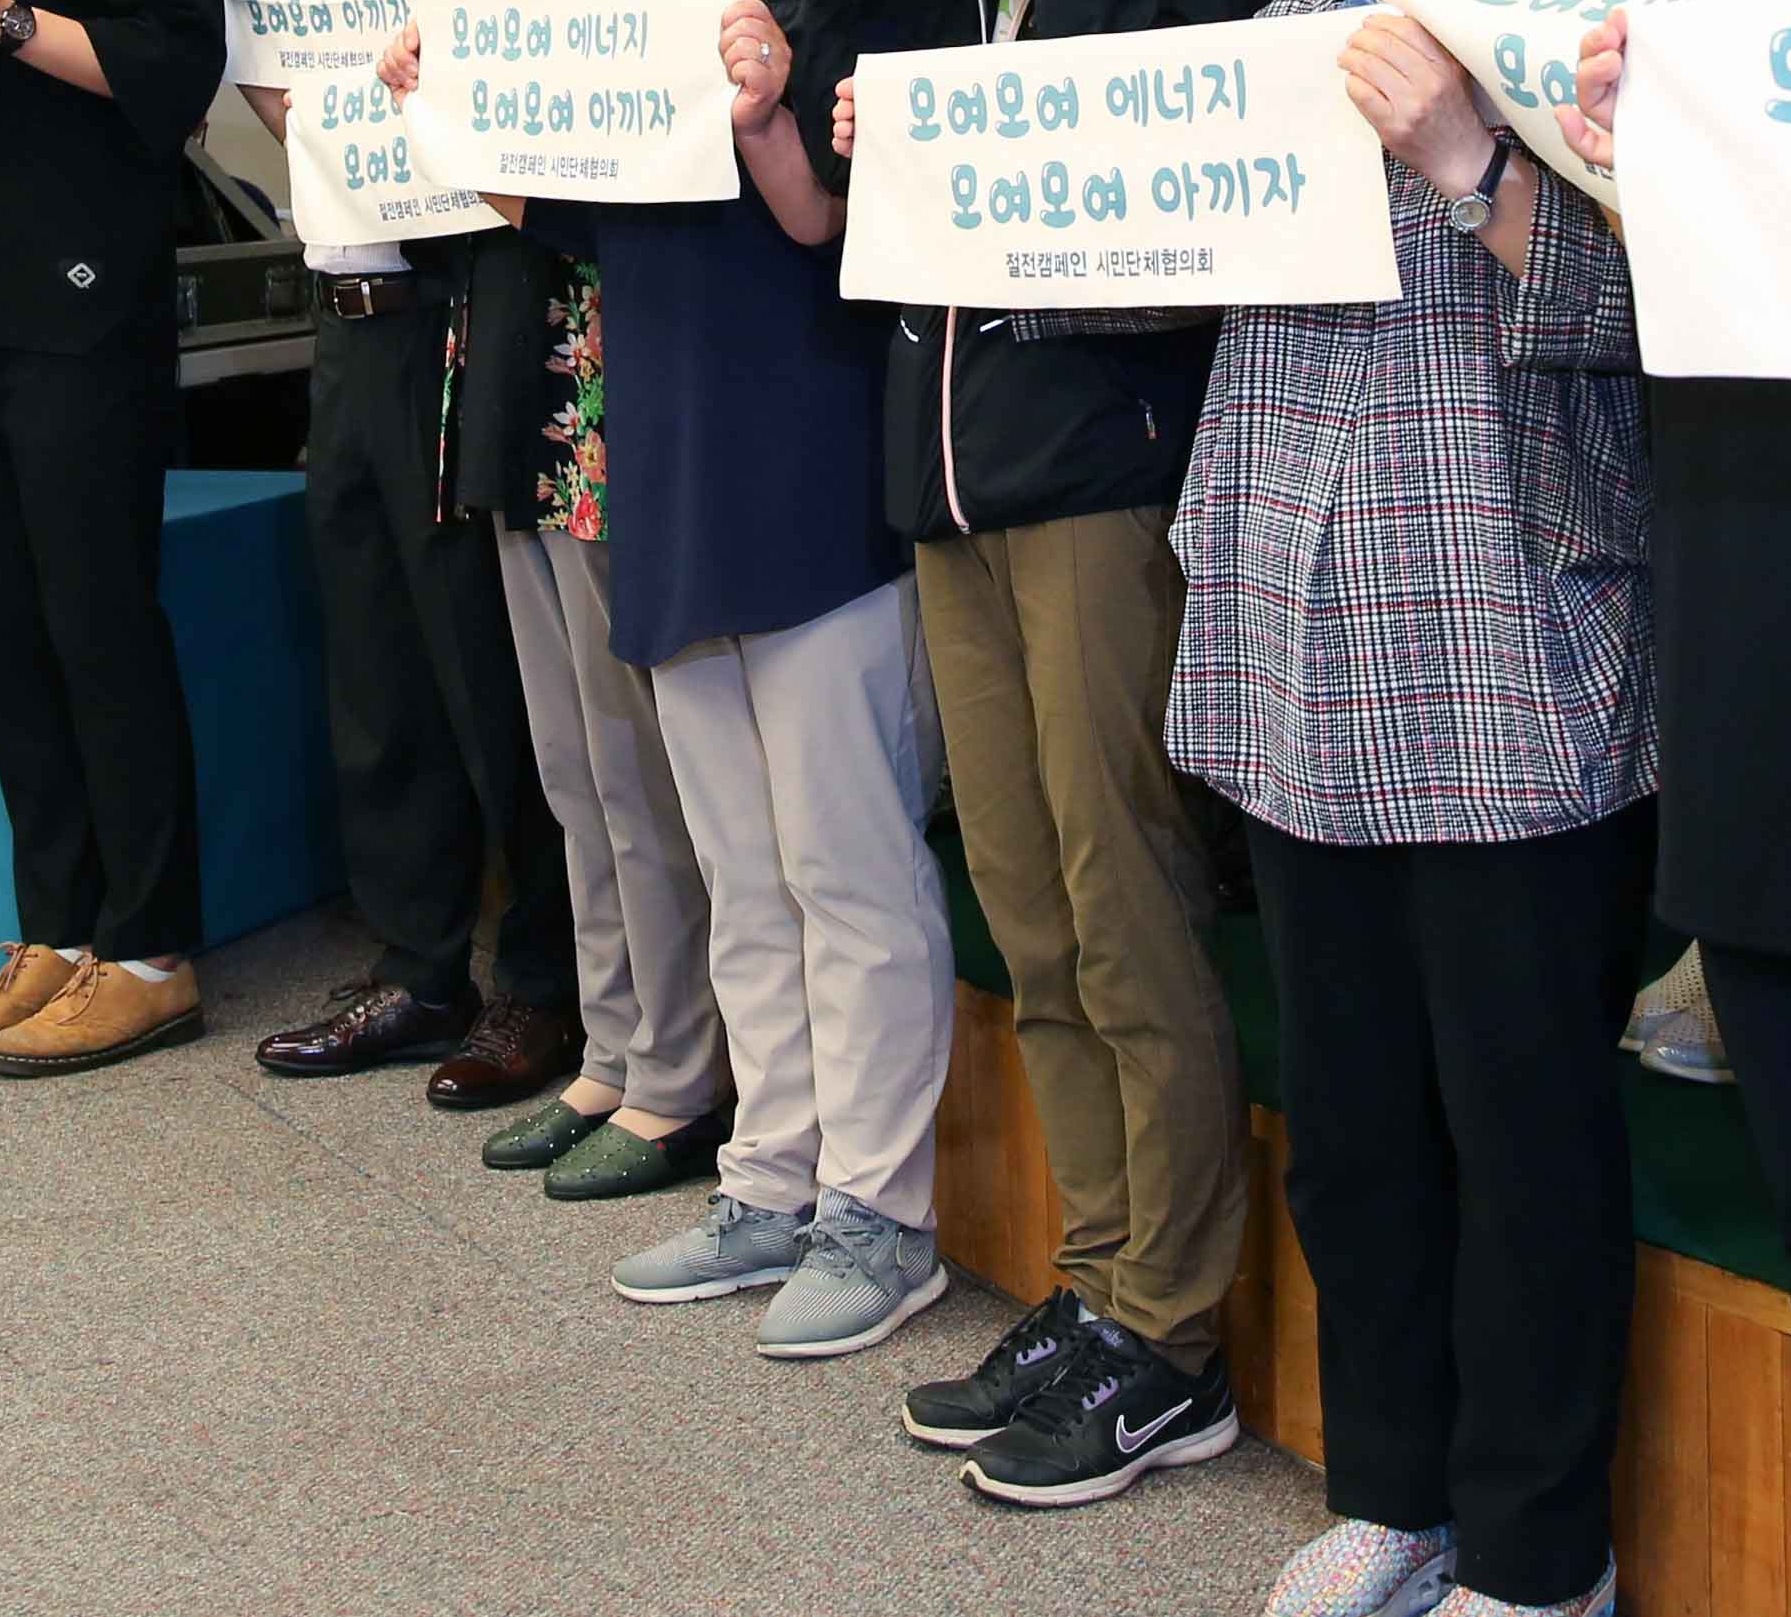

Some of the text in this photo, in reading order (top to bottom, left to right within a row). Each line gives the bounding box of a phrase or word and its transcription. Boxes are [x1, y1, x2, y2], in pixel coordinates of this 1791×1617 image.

[452, 7, 647, 61] 모여모여 에너지
[472, 79, 676, 136] 모여모여 아끼자
[909, 59, 1246, 142] 모여모여 에너지
[345, 136, 411, 190] 모여모
[499, 154, 618, 180] 절전캠페인 시민단체협의회
[951, 153, 1305, 230] 모여모여 아끼자
[1006, 247, 1213, 278] 절전캠페인 시민단체협의회
